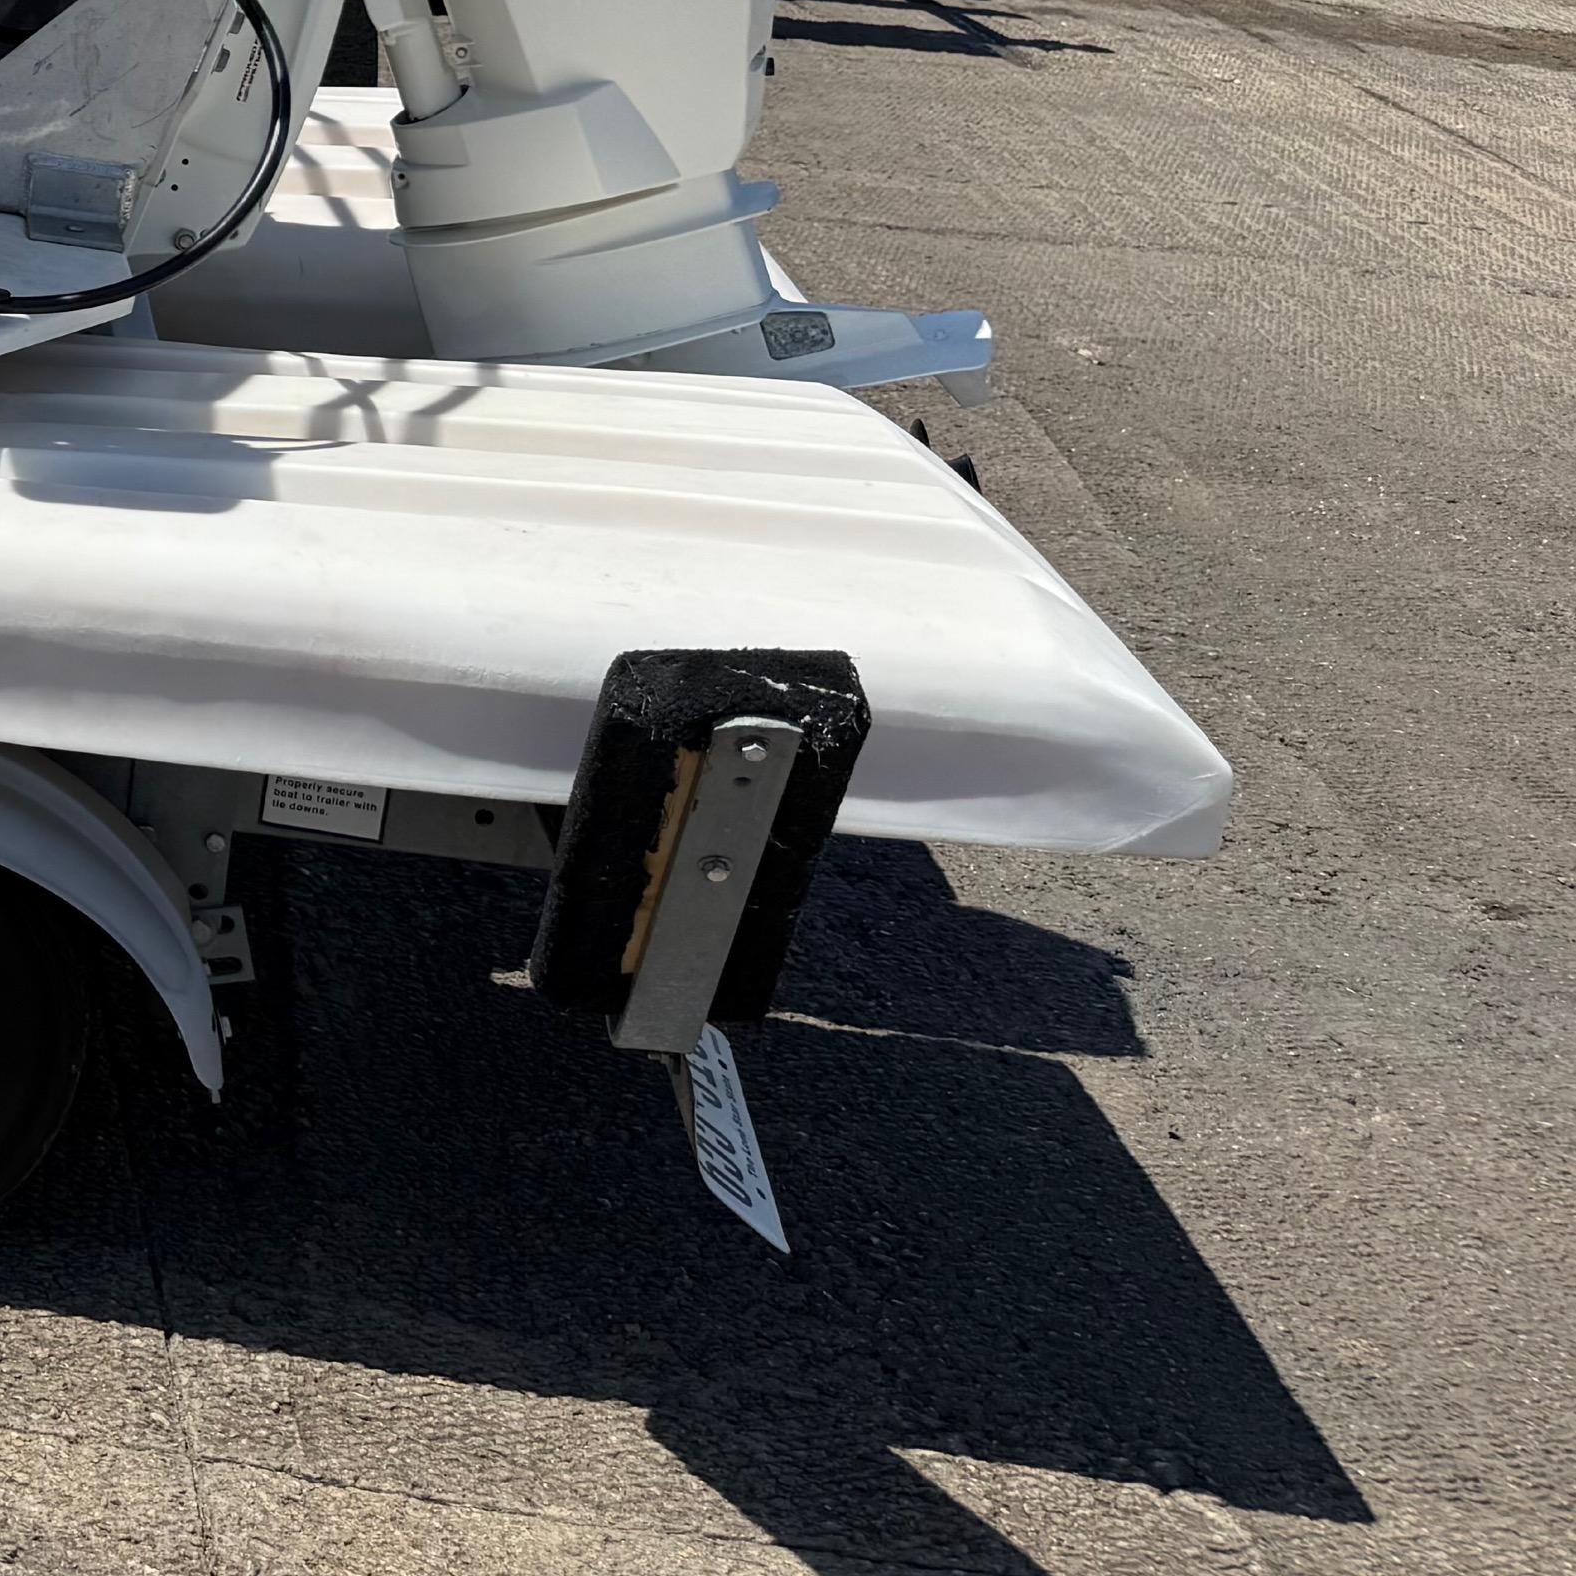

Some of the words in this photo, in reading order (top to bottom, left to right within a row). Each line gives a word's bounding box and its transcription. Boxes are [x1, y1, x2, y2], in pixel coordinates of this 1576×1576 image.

[275, 776, 323, 792] Properly
[327, 786, 364, 798] secure
[272, 799, 286, 809] tie
[273, 787, 298, 799] boat
[302, 792, 313, 802] to
[317, 796, 350, 807] trailer
[354, 800, 378, 812] with
